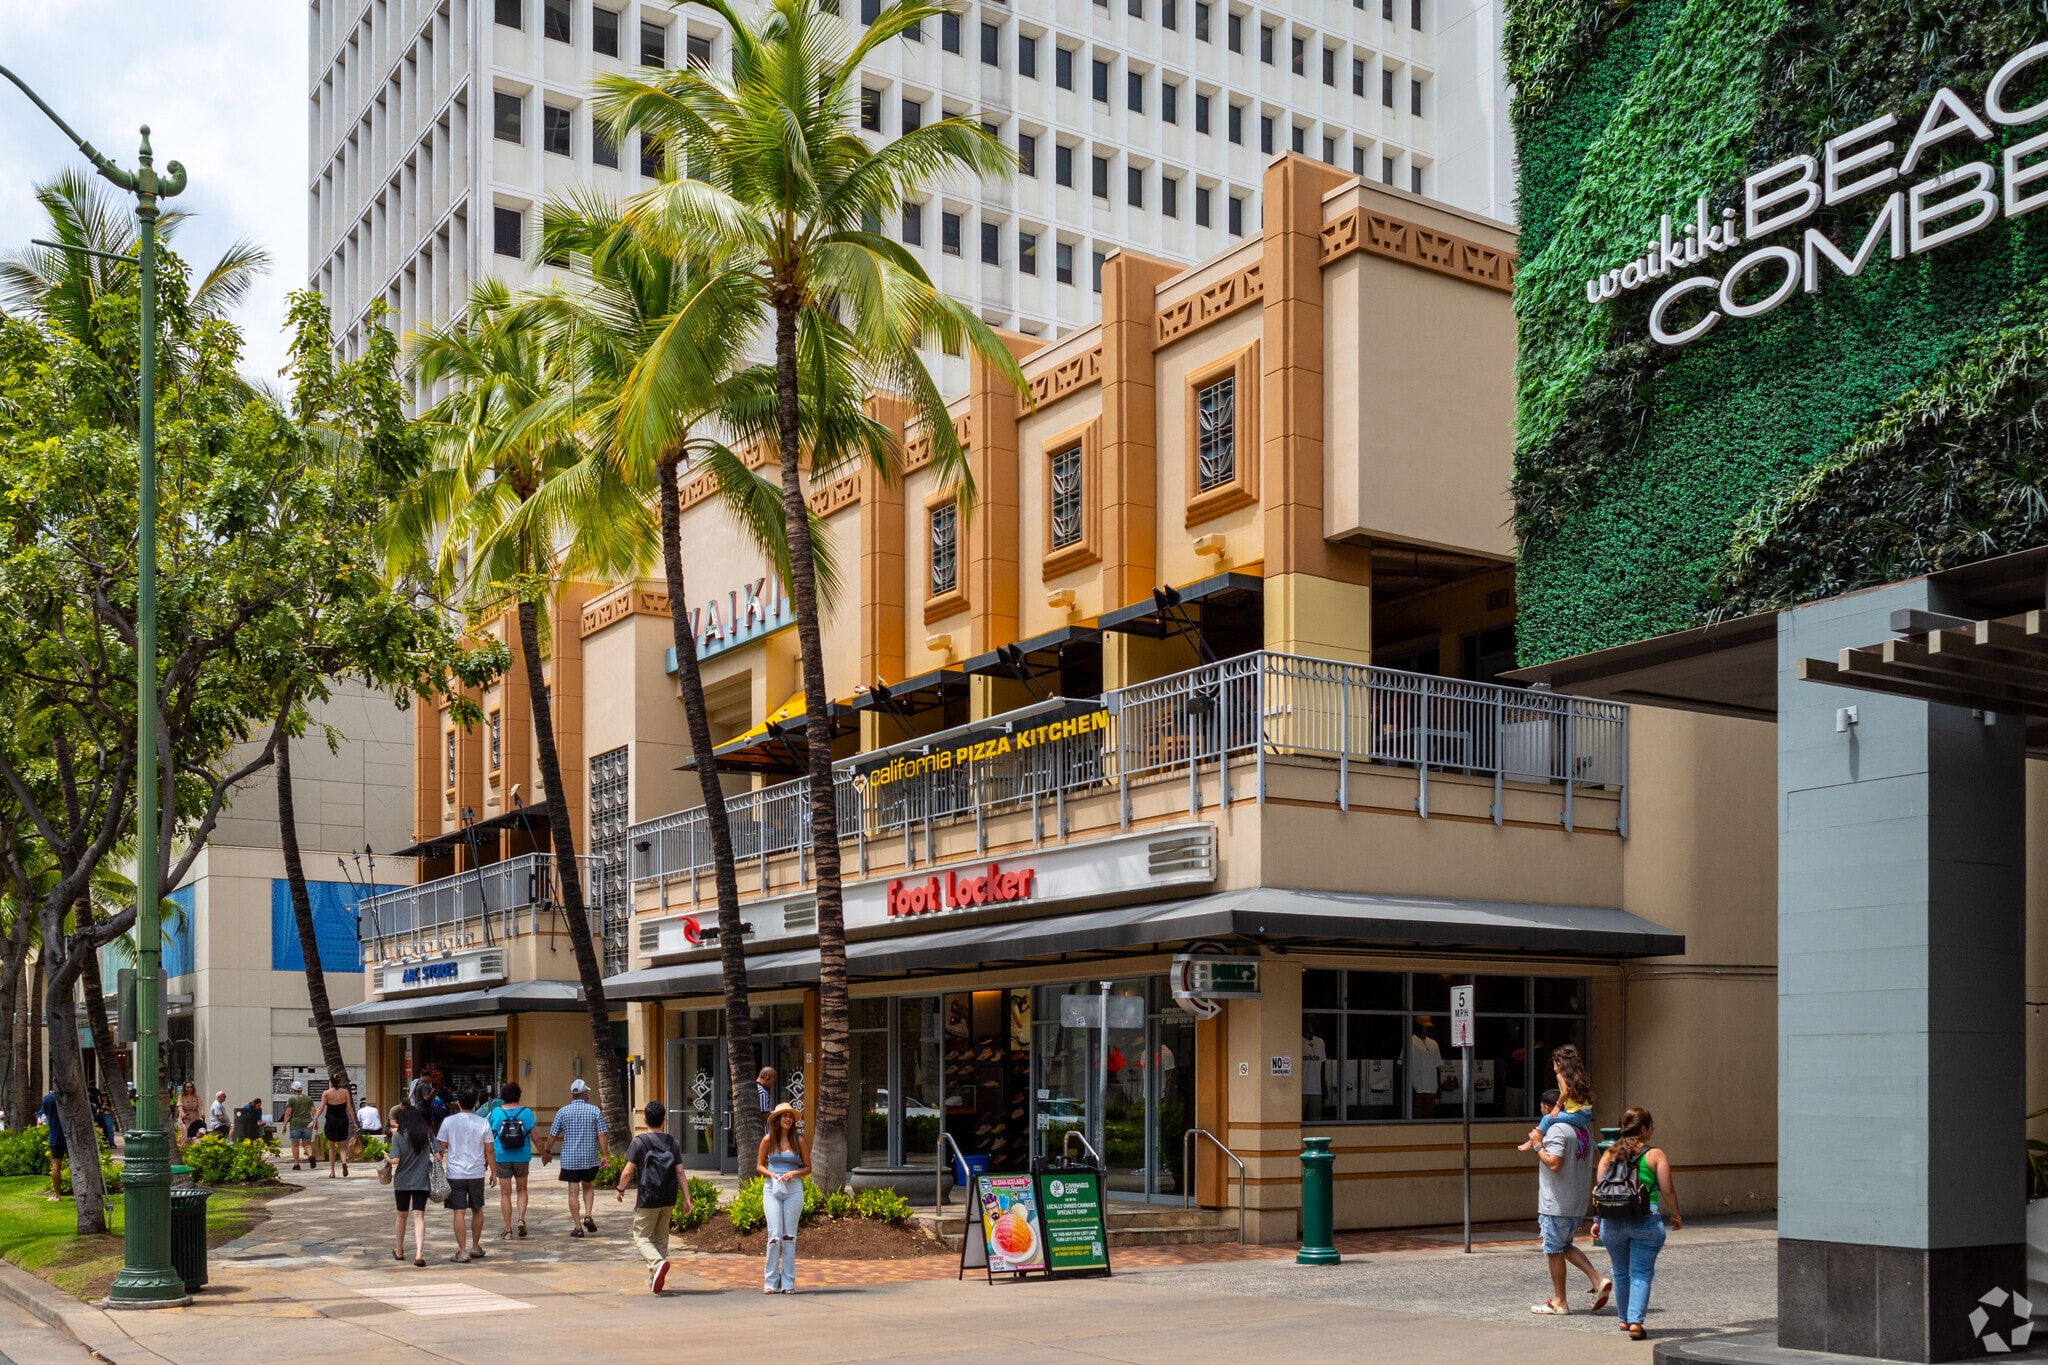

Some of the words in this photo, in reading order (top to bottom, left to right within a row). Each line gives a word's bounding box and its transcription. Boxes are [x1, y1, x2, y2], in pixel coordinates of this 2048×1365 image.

[1587, 197, 1740, 303] waikiki
[870, 747, 951, 787] california
[956, 736, 1010, 765] PIZZA
[1016, 709, 1109, 750] KITCHEN
[887, 876, 941, 917] Foot
[945, 863, 1035, 908] Locker
[402, 967, 420, 983] ABC
[422, 961, 458, 980] STORES
[1459, 992, 1465, 1007] 5
[1272, 1057, 1282, 1068] NO
